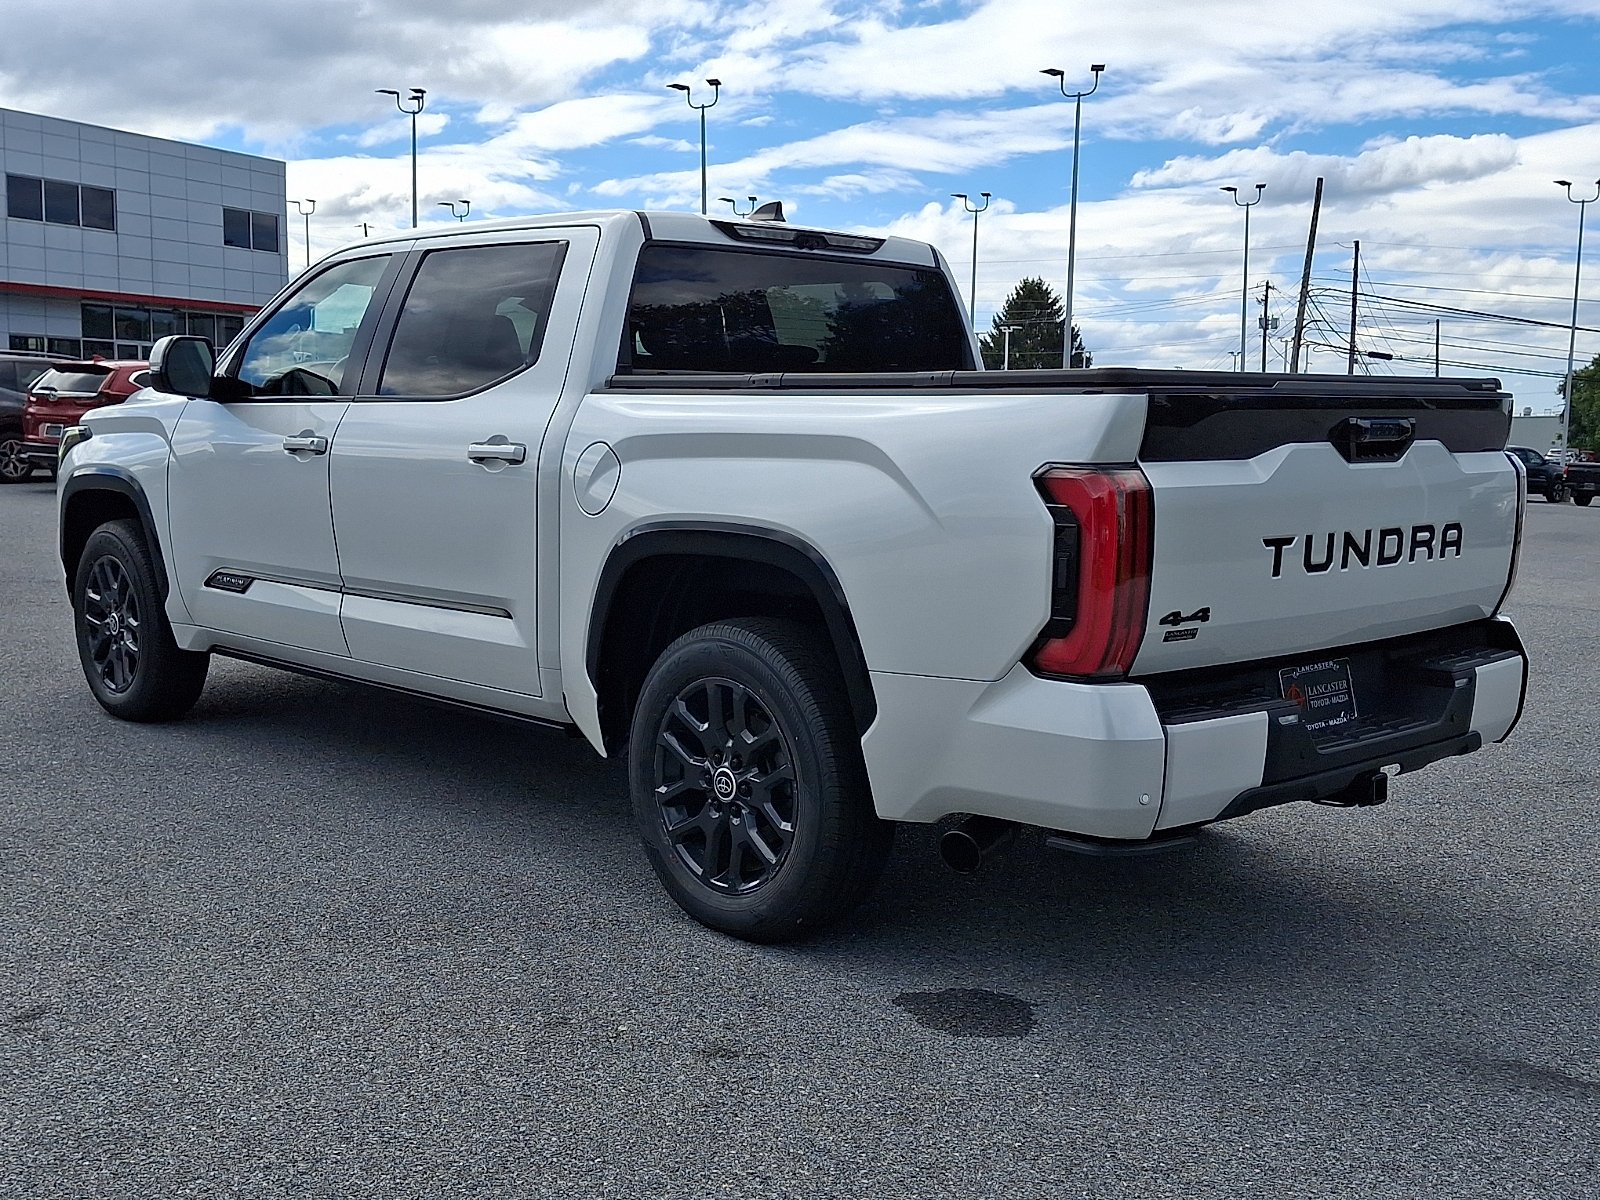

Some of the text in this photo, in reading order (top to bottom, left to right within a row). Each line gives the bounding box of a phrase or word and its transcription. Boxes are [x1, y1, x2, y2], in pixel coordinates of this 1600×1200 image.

[1262, 522, 1463, 578] TUNDRA
[1297, 661, 1334, 672] LANCASTER
[1308, 680, 1348, 696] LANCASTER
[1306, 722, 1325, 731] OYOTA
